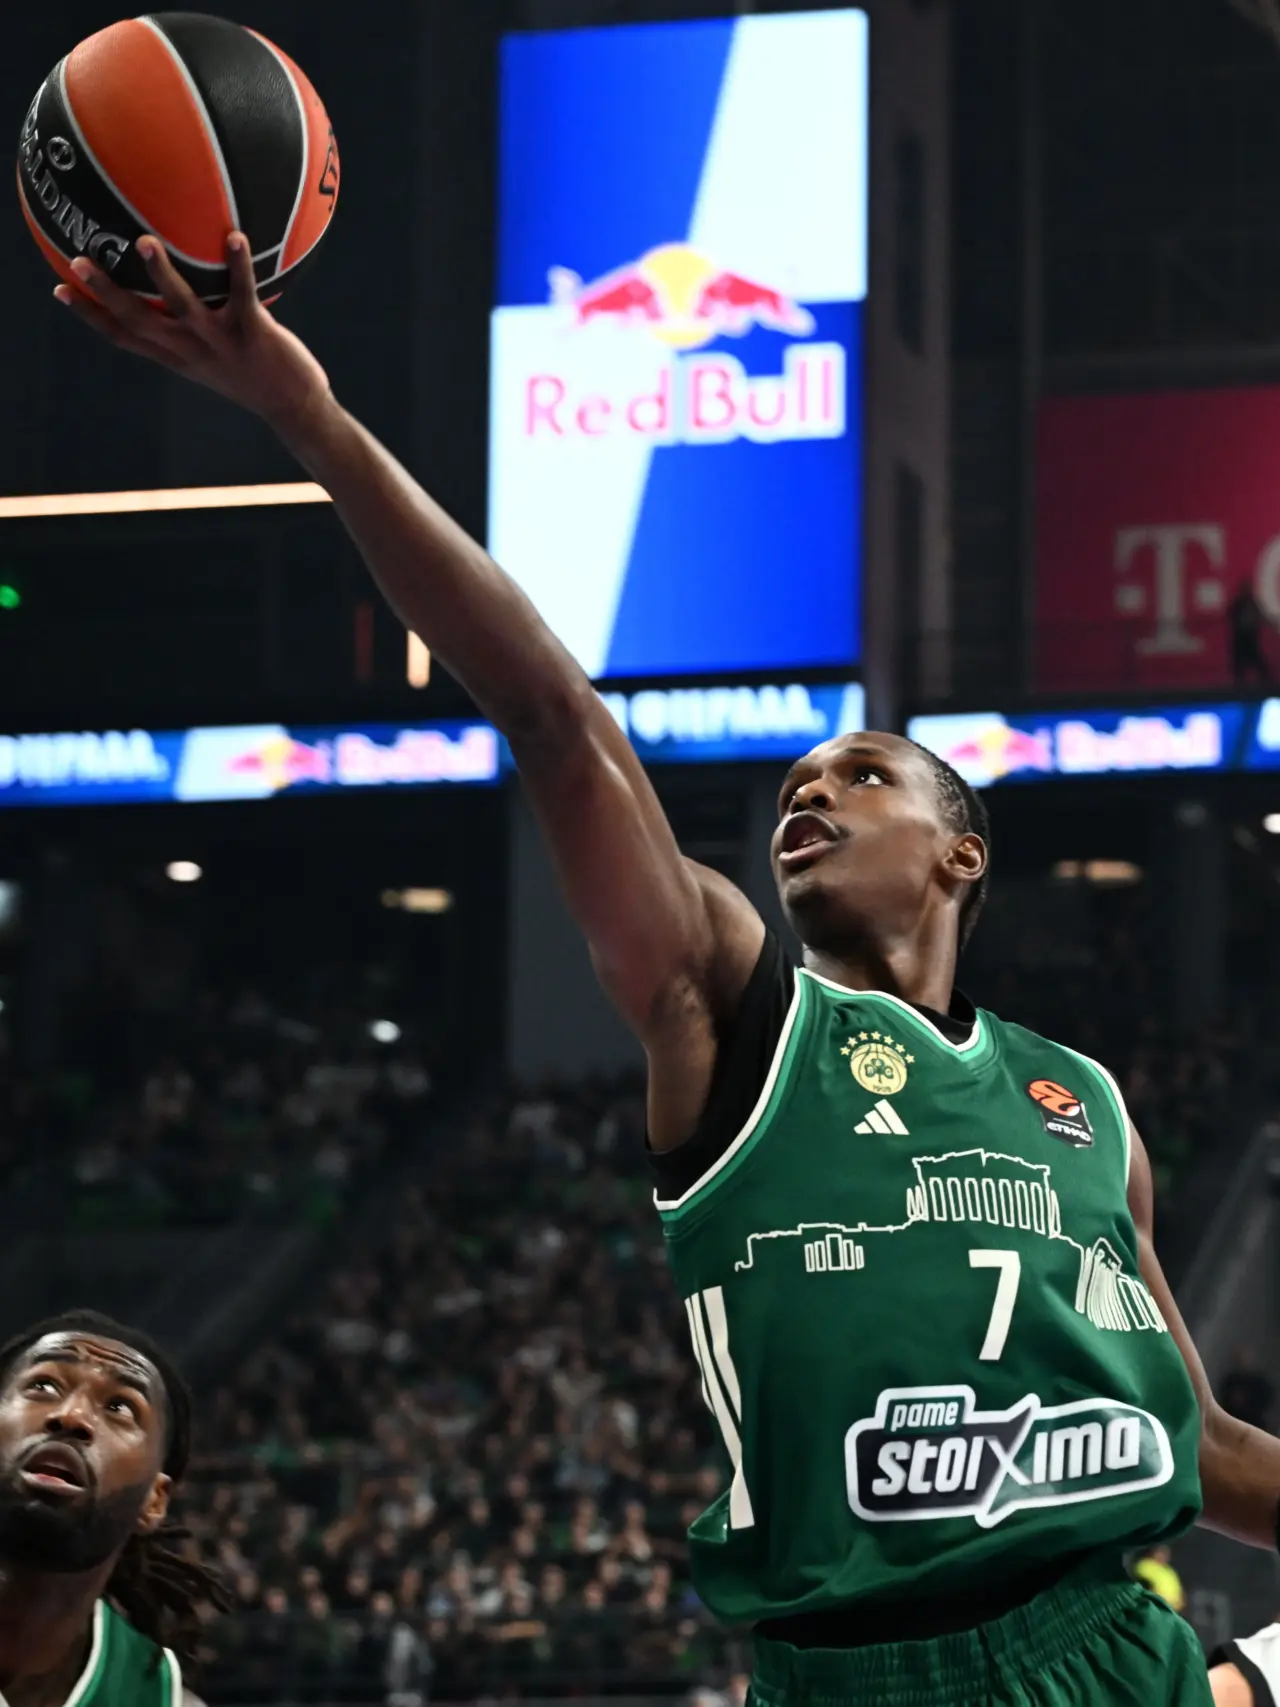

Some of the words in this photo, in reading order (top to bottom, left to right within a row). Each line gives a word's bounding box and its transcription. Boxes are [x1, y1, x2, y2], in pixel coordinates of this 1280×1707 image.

[523, 366, 669, 438] Red
[690, 357, 833, 431] Bull
[1114, 523, 1226, 656] T
[968, 1249, 1021, 1361] 7
[890, 1401, 960, 1432] pame
